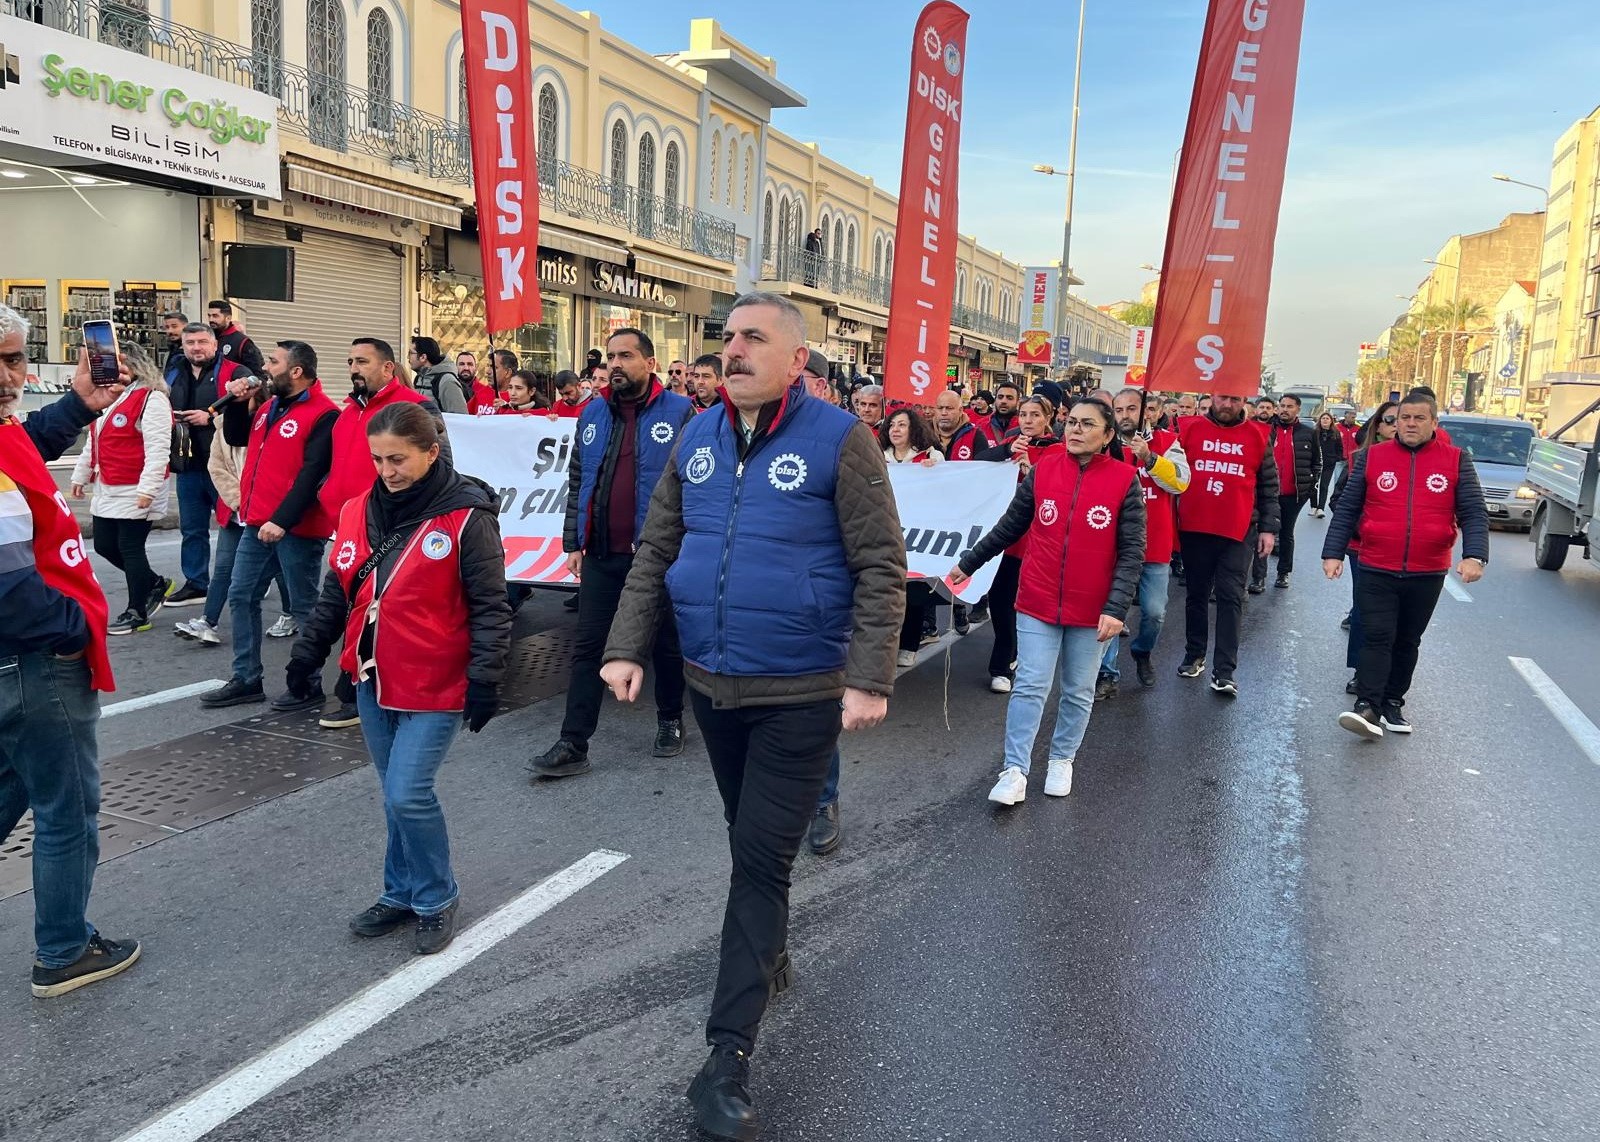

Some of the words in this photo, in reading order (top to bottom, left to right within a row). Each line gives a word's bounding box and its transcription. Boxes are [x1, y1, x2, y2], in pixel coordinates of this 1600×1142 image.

[41, 53, 154, 112] Şener
[161, 88, 272, 145] Çağlar
[917, 70, 960, 123] DİSK
[53, 135, 94, 152] TELEFON
[104, 147, 153, 165] BİLGİSAYAR
[163, 159, 192, 174] TEKNİK
[193, 167, 220, 180] SERVİS
[228, 174, 266, 191] AKSESUAR
[111, 124, 220, 163] BİLİŞİM
[480, 11, 525, 301] DİSK
[532, 434, 569, 479] Şi
[1194, 459, 1246, 478] GENEL
[1202, 439, 1245, 456] DİSK
[775, 464, 798, 476] DİSK
[1206, 476, 1224, 496] İŞ
[358, 551, 382, 580] Calvin
[380, 532, 403, 555] Klein
[900, 524, 984, 559] un!
